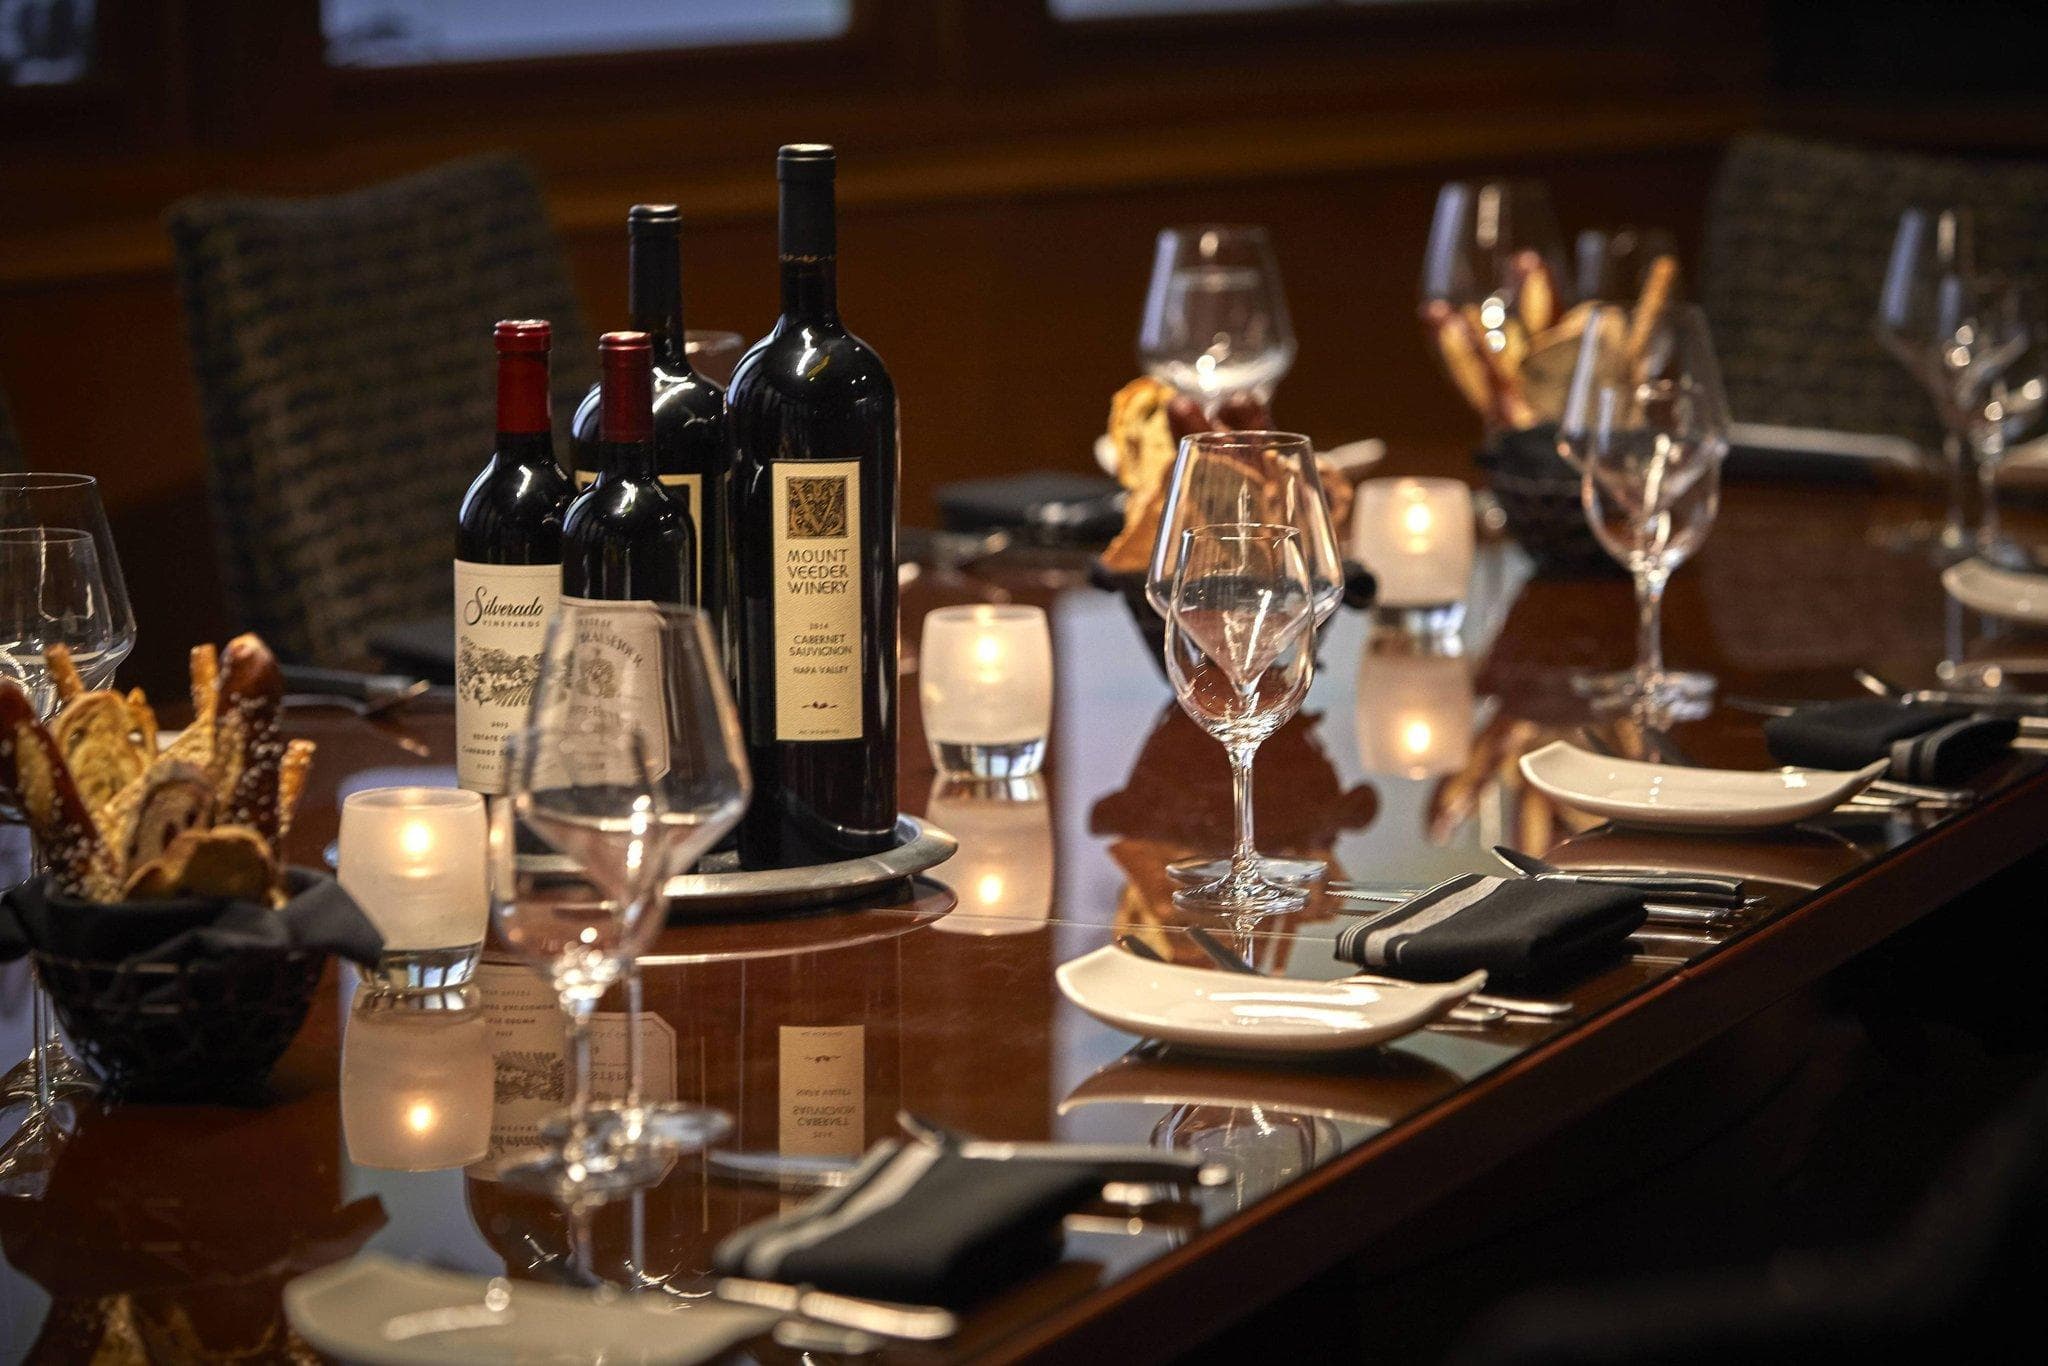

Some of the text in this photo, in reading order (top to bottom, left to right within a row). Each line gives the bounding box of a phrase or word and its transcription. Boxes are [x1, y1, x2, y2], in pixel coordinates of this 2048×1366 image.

[786, 548, 849, 563] MOUNT
[786, 564, 849, 579] VEEDER
[786, 580, 849, 595] WINERY
[463, 586, 544, 626] Silverado
[482, 619, 541, 628] VINEYARDS
[793, 633, 847, 644] CABERNET
[789, 645, 853, 657] SAUVIGNON
[793, 665, 849, 674] NAPA VALLEY
